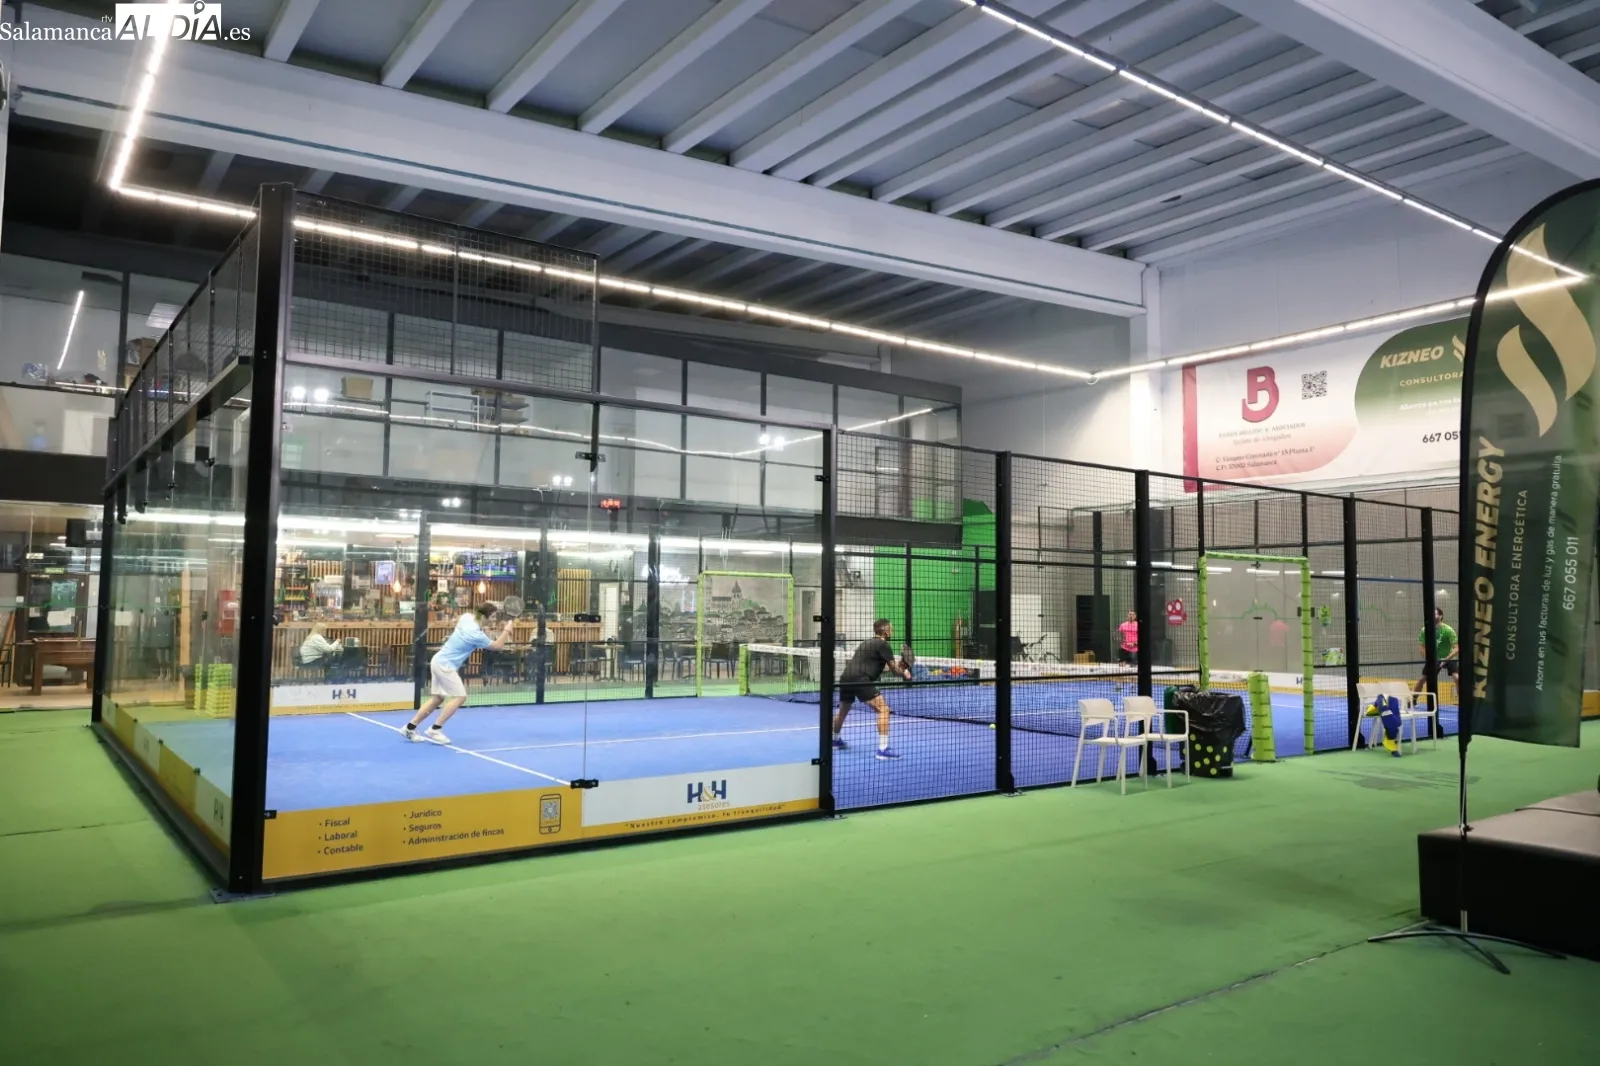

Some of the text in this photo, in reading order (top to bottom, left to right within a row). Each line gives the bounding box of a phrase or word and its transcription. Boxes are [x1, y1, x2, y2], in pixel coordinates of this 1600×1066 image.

[1380, 345, 1444, 368] KIZNEO
[1399, 371, 1464, 387] CONSULTORA
[1422, 431, 1461, 443] 667 05
[1552, 455, 1562, 489] gratuita
[1548, 491, 1558, 524] manera
[1547, 526, 1555, 538] de
[1546, 539, 1555, 555] gas
[1473, 435, 1504, 698] KIZNEO ENERGY
[1542, 564, 1553, 578] luz
[1563, 536, 1579, 611] 667 055 011
[1506, 490, 1528, 660] CONSULTORA ENERGÉTICA
[1541, 579, 1551, 591] de
[1538, 593, 1550, 628] facturas
[1539, 631, 1547, 645] tus
[1538, 646, 1545, 659] en
[1535, 660, 1544, 691] Ahorra
[687, 779, 727, 803] H&H
[697, 800, 731, 811] asesores
[324, 816, 350, 828] Fiscal
[408, 823, 442, 833] Seguros
[324, 830, 358, 842] Laboral
[408, 828, 504, 846] Administración de fincas
[323, 843, 364, 855] Contable
